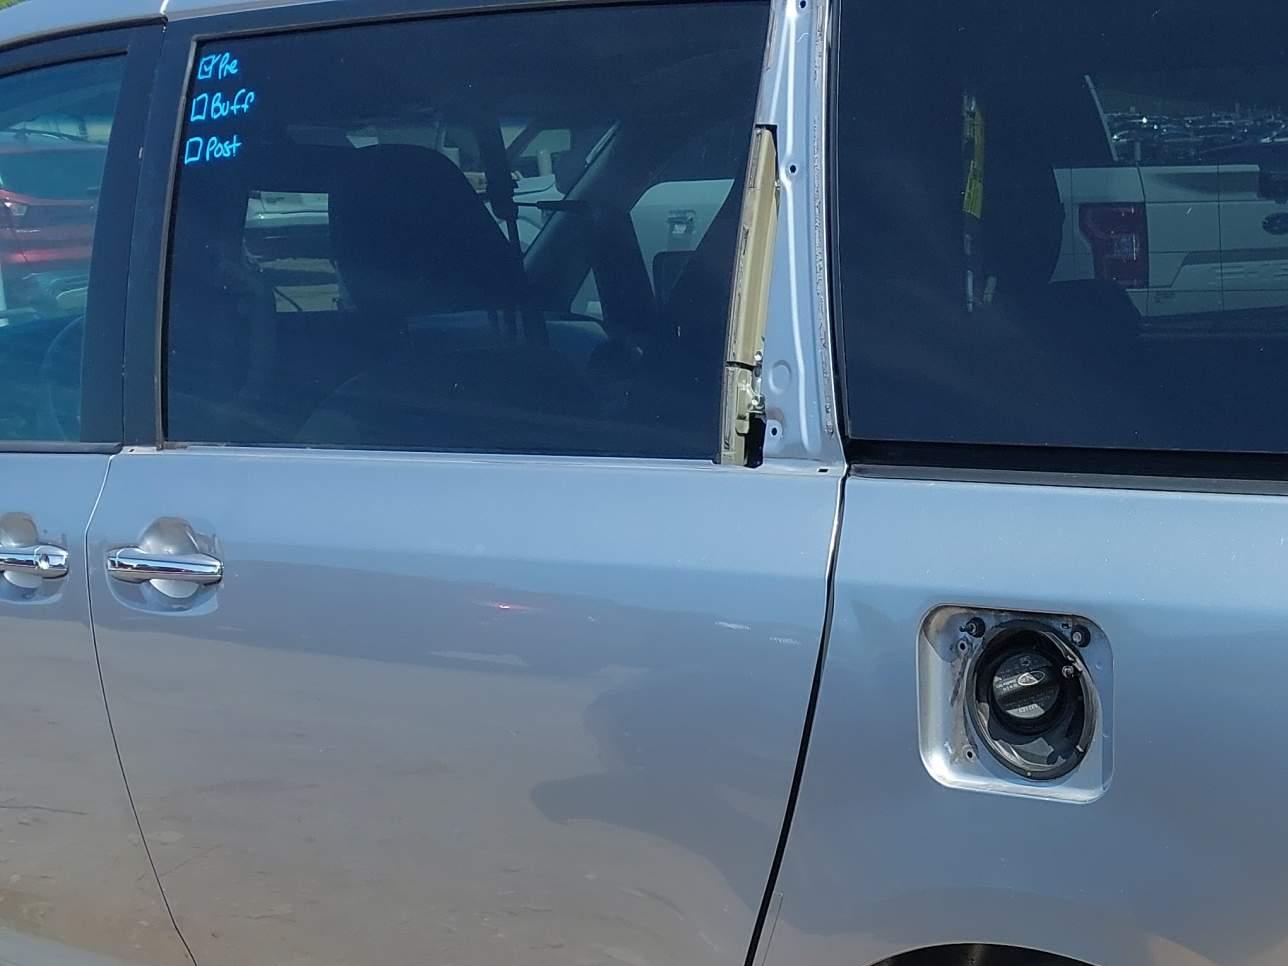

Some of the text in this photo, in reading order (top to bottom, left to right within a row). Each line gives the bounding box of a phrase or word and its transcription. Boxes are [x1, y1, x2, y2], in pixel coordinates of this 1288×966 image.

[218, 52, 239, 80] Pre
[210, 88, 255, 119] Buff
[205, 134, 243, 161] Post
